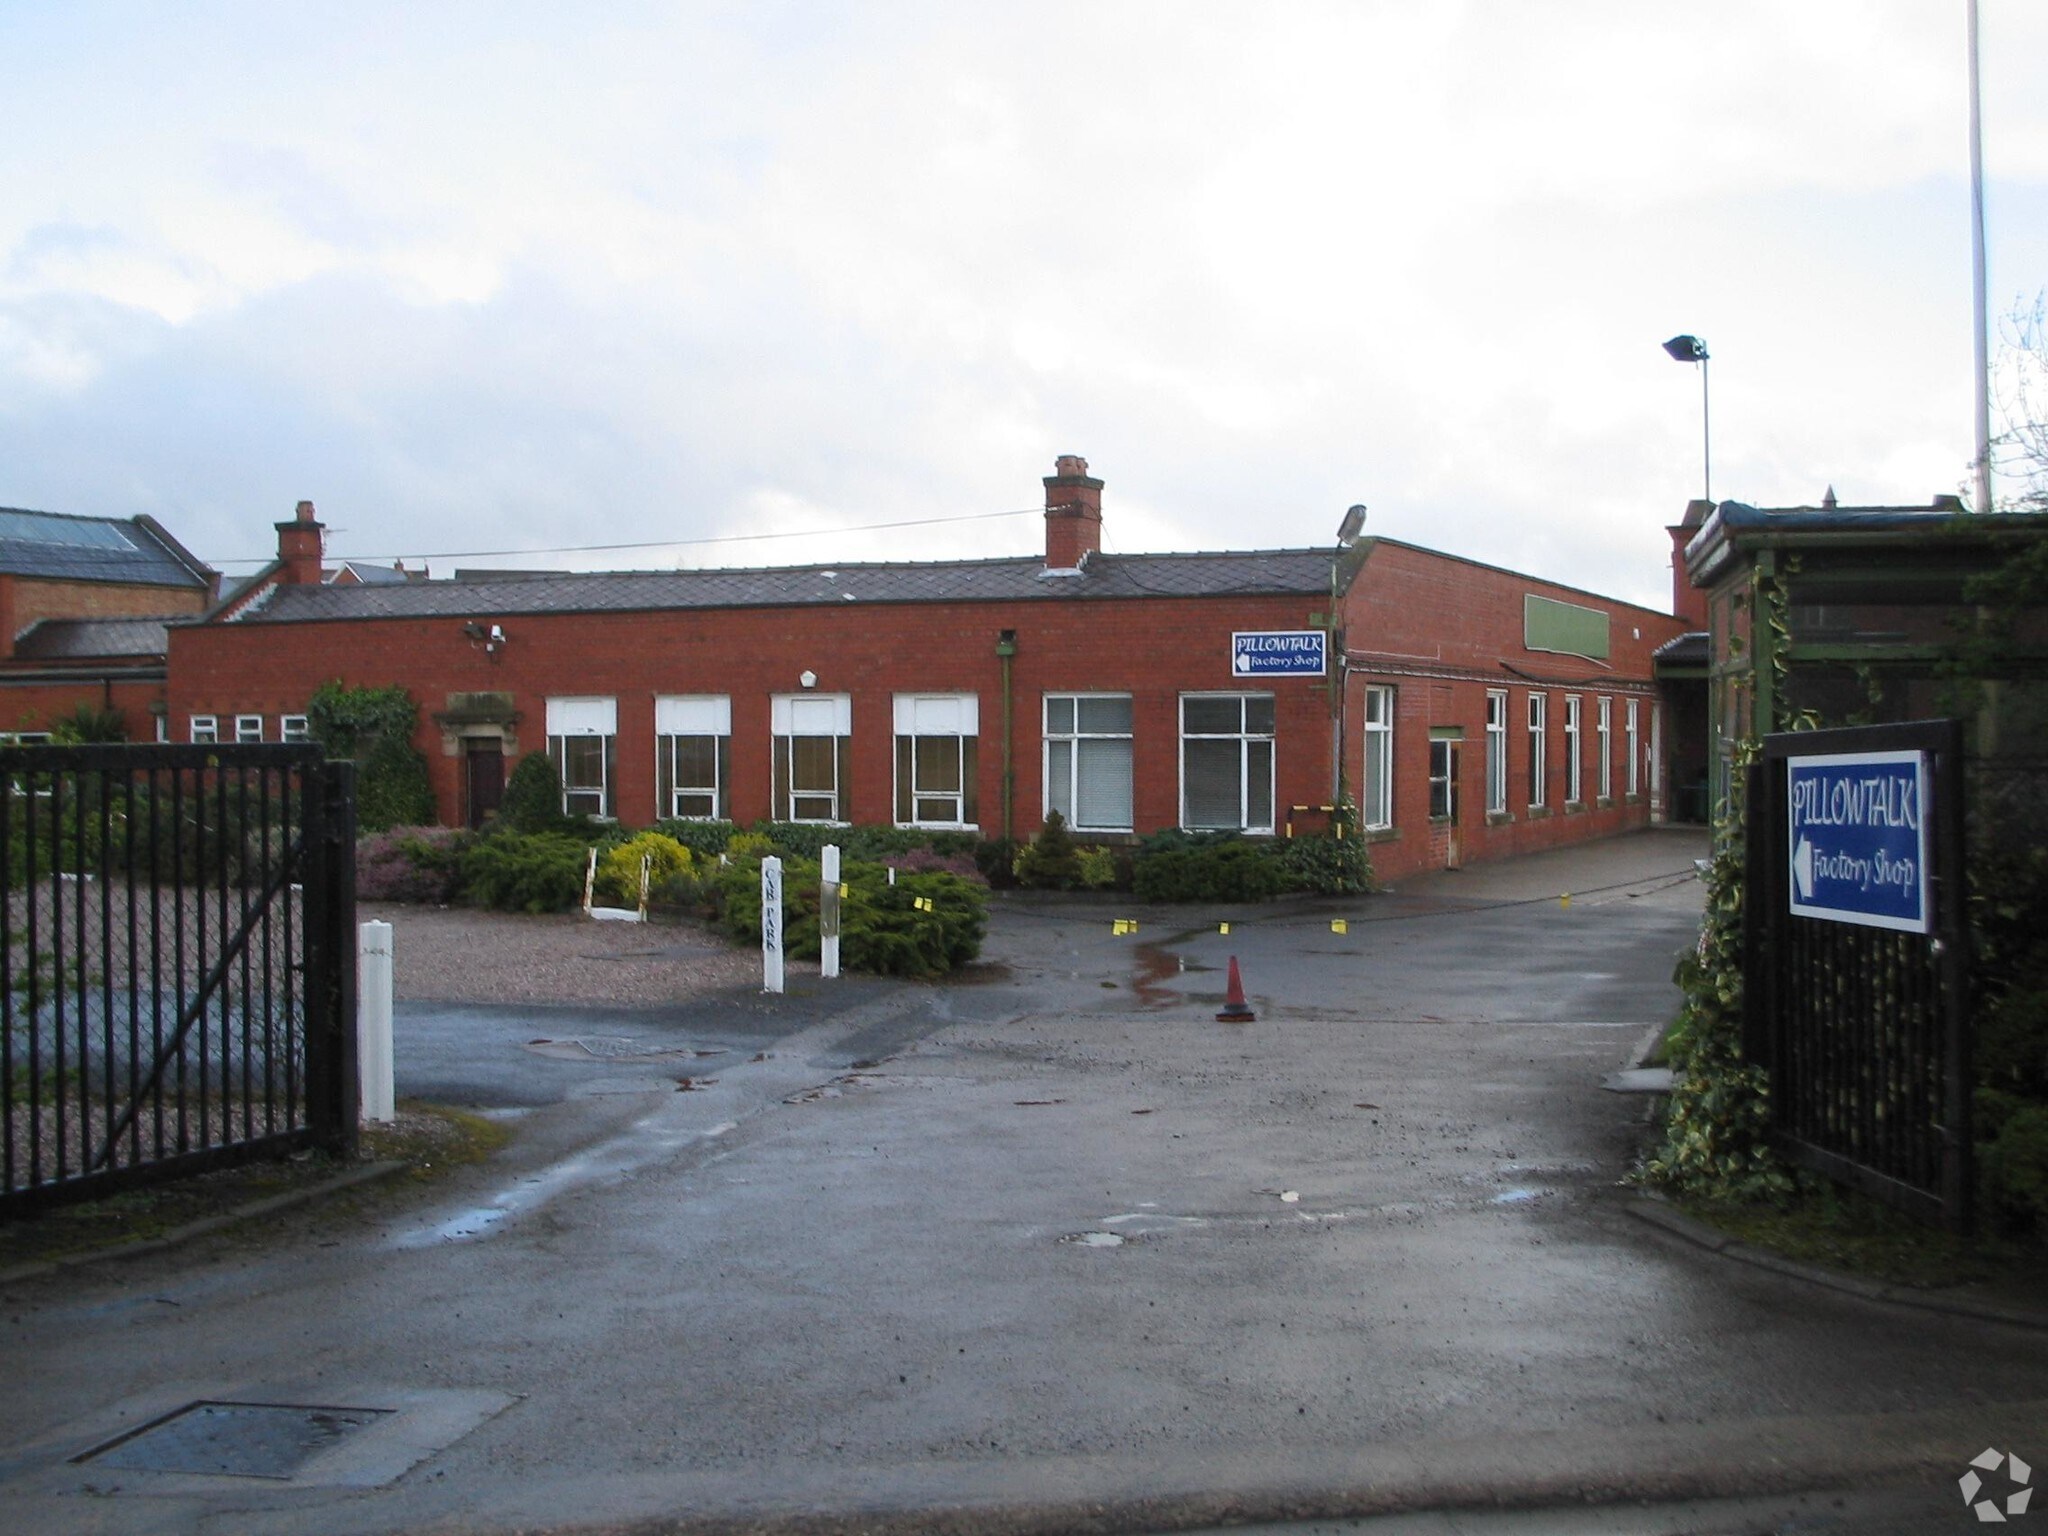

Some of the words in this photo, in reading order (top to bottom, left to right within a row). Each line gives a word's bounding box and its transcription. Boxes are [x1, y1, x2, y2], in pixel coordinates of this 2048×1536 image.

[1237, 636, 1322, 652] PILLOWTALK
[1251, 655, 1293, 668] Factory
[1293, 654, 1320, 668] Shop
[1792, 775, 1918, 831] PILLOWTALK
[765, 868, 775, 901] CAR
[1812, 848, 1871, 892] Factory
[1873, 848, 1914, 898] Shop
[766, 906, 776, 952] PARK
